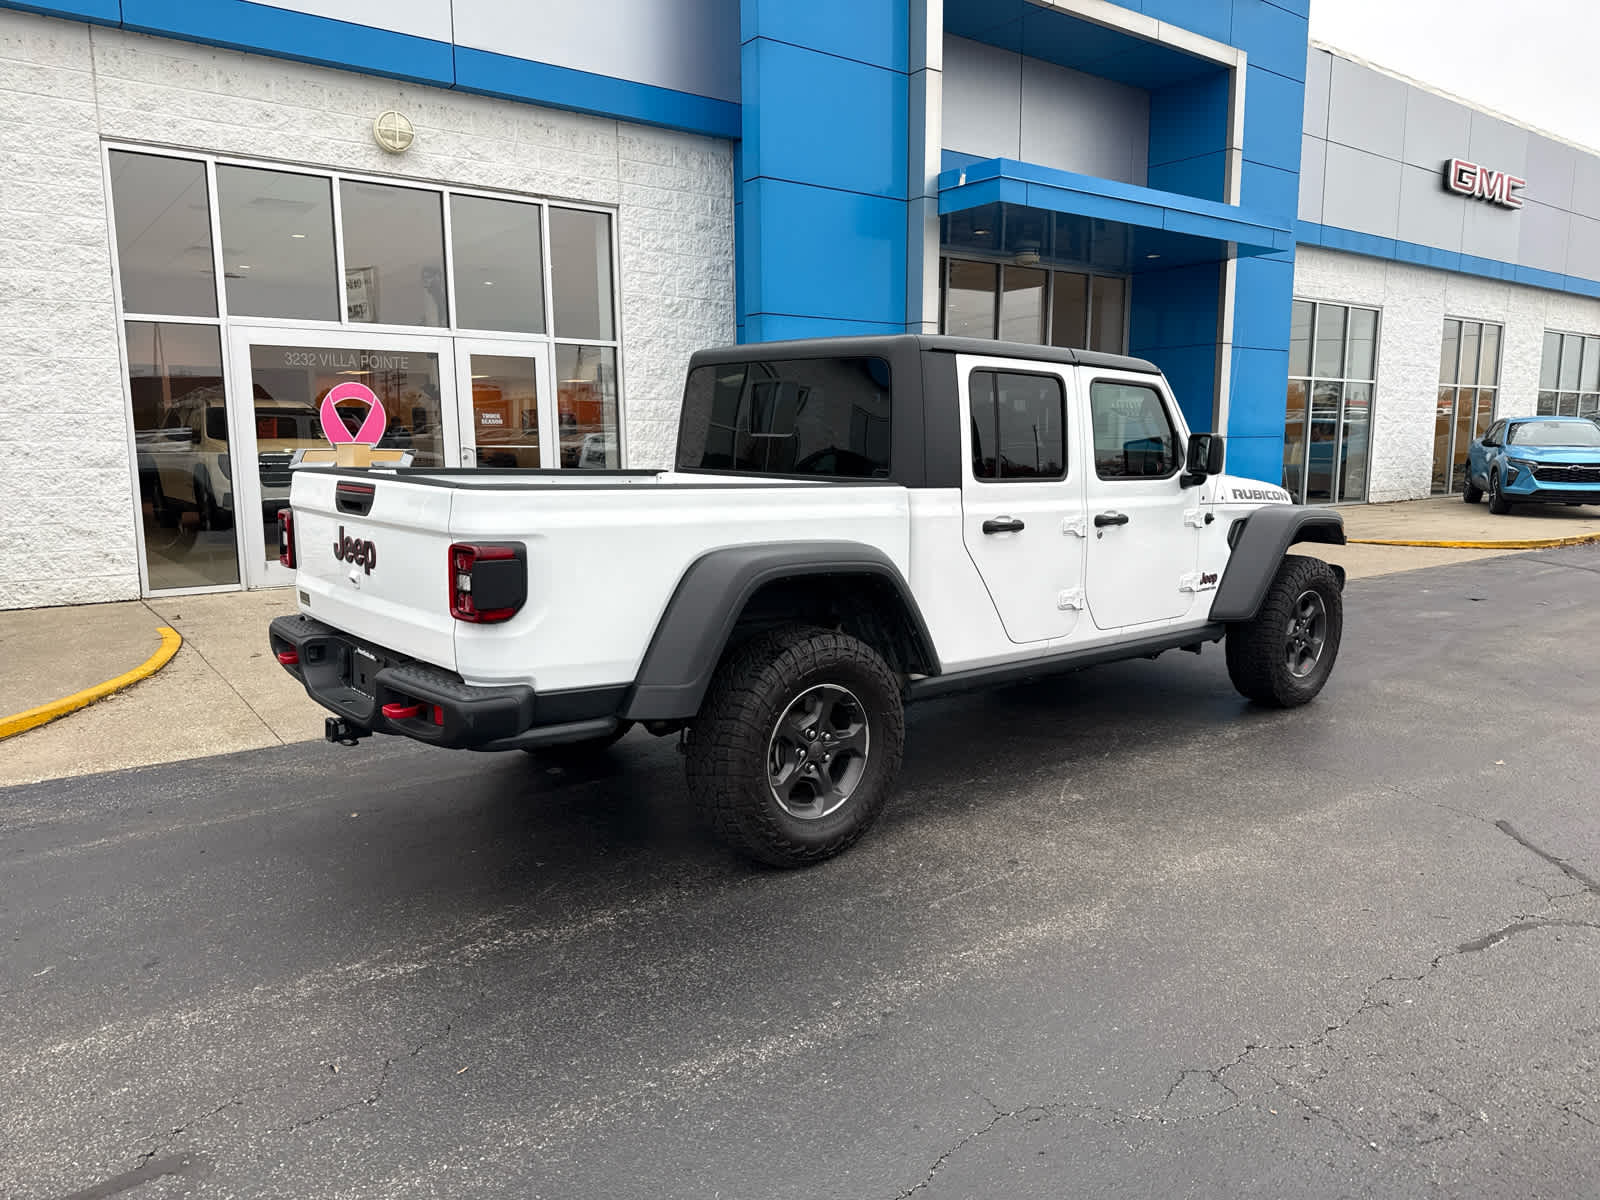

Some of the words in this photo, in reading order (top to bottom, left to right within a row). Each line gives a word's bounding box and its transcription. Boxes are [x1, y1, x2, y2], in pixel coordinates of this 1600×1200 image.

[1450, 158, 1527, 208] GMC
[284, 352, 317, 366] 3232
[319, 353, 358, 367] VILLA
[360, 355, 409, 369] POINTE
[1231, 488, 1289, 502] RUBICON
[333, 525, 377, 576] Jeep
[1199, 571, 1218, 586] Jeep
